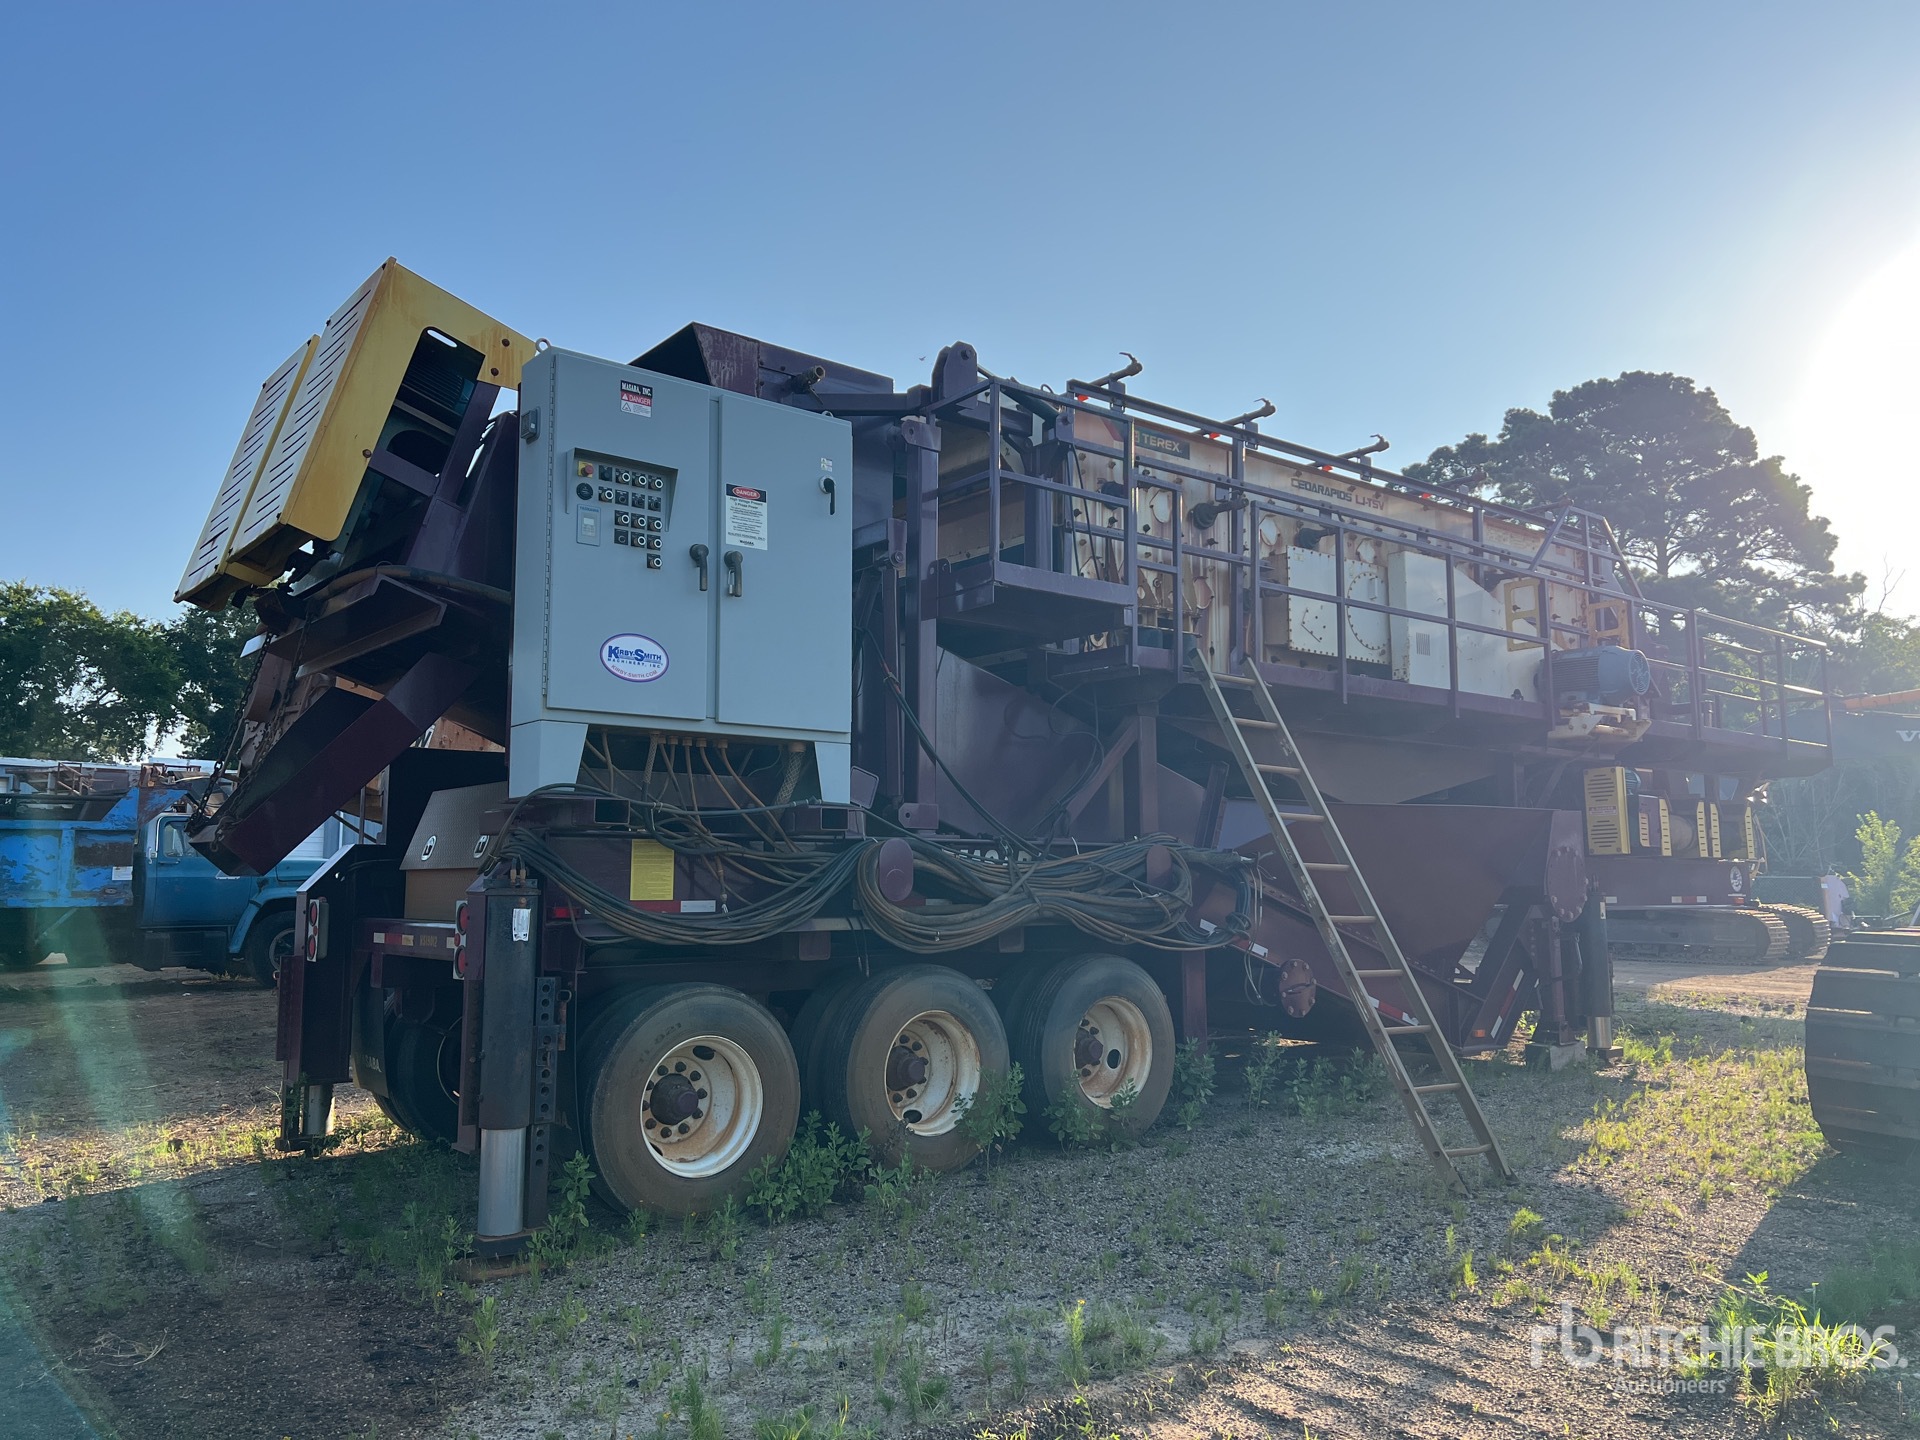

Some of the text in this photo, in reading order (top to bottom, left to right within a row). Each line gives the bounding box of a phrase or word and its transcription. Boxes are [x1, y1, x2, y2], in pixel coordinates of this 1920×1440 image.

[629, 394, 651, 406] DANGER
[1141, 433, 1180, 453] TEREX
[736, 489, 757, 497] DANGER
[1290, 478, 1353, 502] CEDARAPIDS
[607, 645, 662, 662] KIRBY-SMITH
[607, 658, 647, 668] MACHINERY,
[611, 664, 658, 678] KIRBY-SMITH.COM
[1895, 730, 1920, 742] V
